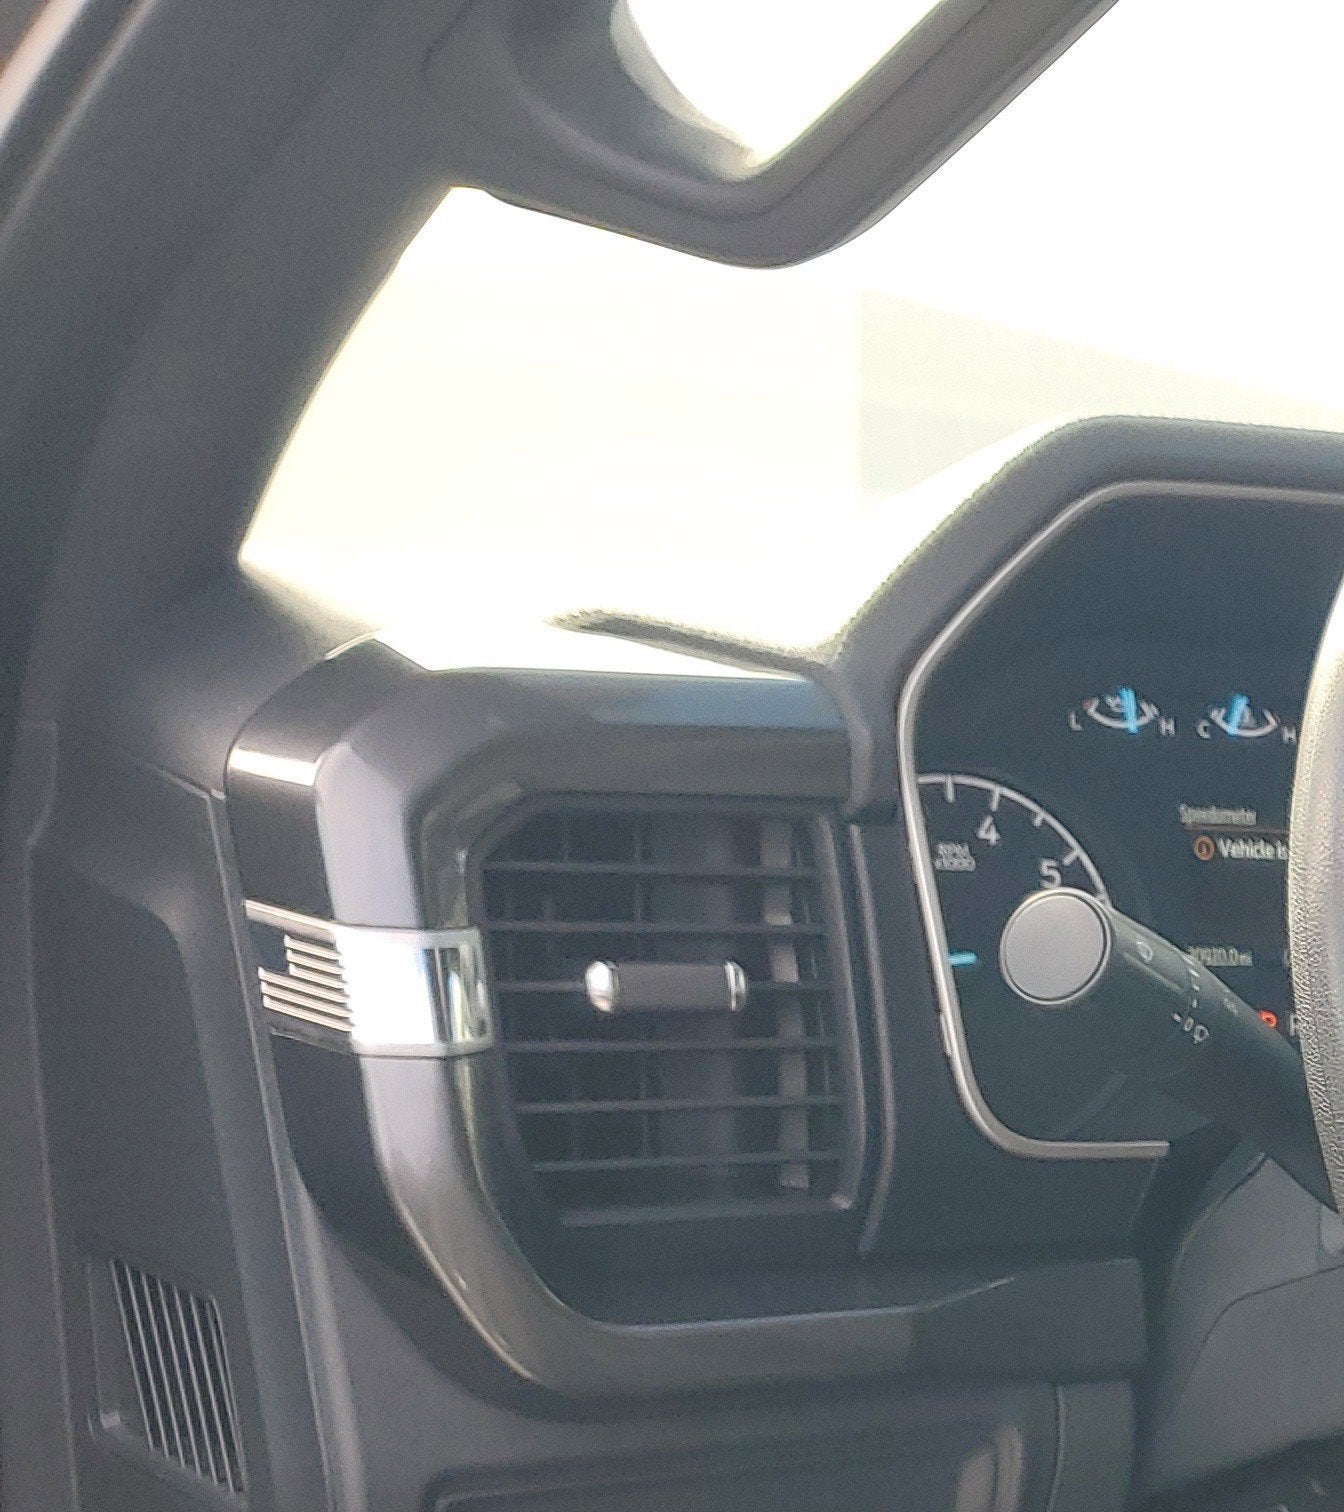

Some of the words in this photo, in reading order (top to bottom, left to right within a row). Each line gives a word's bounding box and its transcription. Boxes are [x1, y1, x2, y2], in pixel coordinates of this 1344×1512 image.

[975, 815, 1000, 846] 4
[1216, 838, 1276, 859] Vehicle
[1041, 858, 1061, 888] 5
